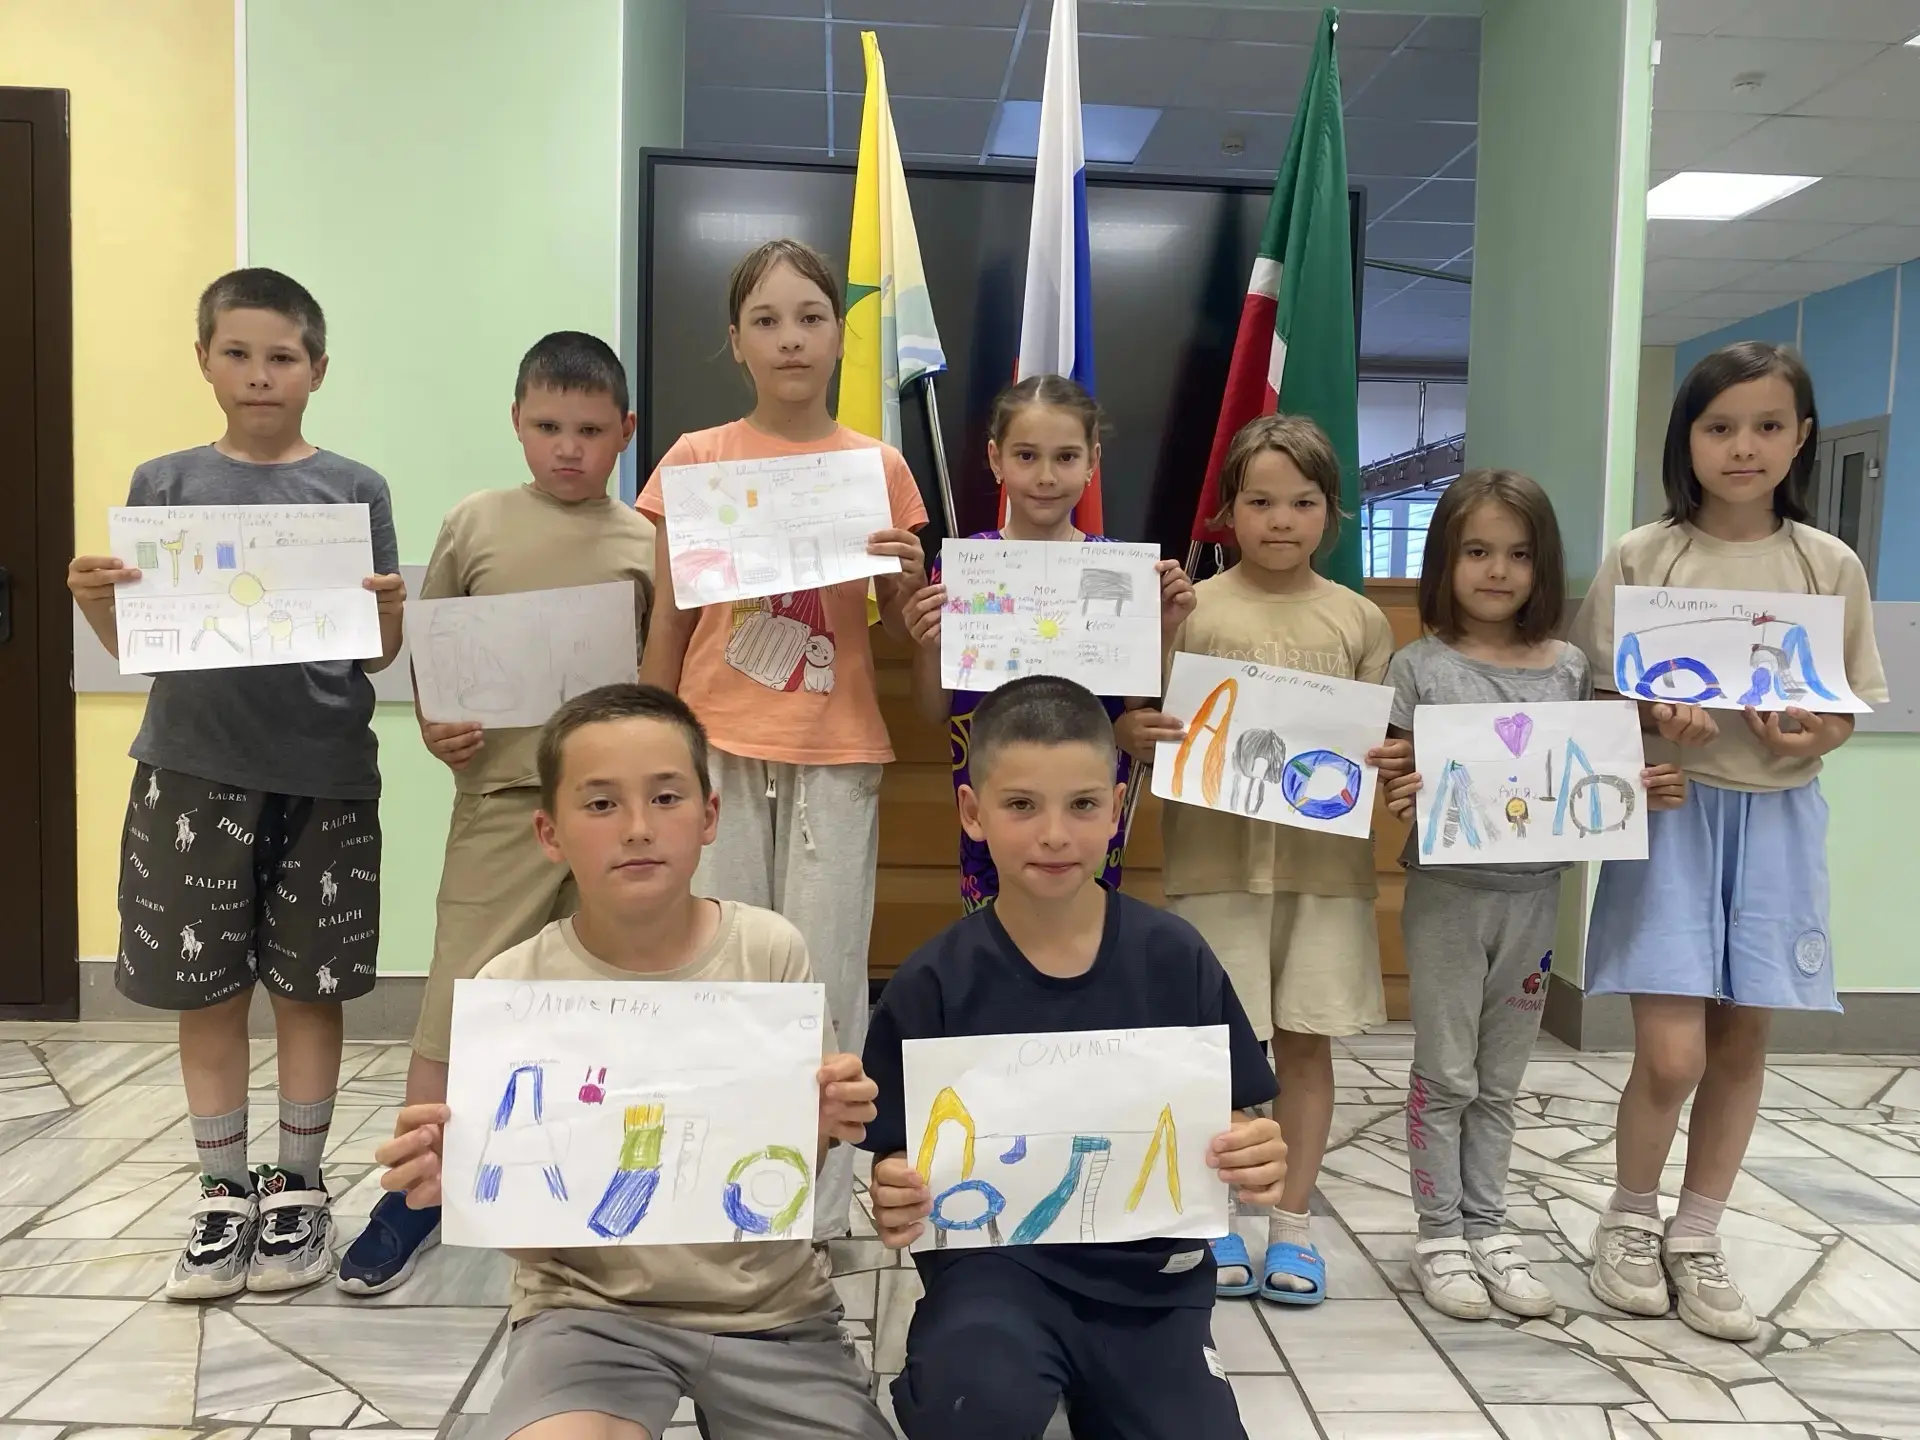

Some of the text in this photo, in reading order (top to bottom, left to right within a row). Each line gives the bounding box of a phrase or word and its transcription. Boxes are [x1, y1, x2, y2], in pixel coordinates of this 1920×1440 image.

[208, 791, 248, 802] LAUREN
[216, 816, 255, 846] POLO
[321, 812, 357, 832] RALPH
[129, 826, 150, 843] AUREN
[340, 834, 374, 848] LAUREN
[129, 851, 150, 879] POLO
[185, 875, 238, 890] RALPH
[350, 867, 377, 883] POLO
[135, 894, 165, 913] LAUREN
[318, 909, 363, 928] RALPH
[134, 924, 159, 950] POLO
[220, 930, 247, 942] POLO
[343, 930, 375, 945] LAUREN
[268, 939, 297, 958] LAUREN
[176, 967, 226, 983] RALPH
[353, 963, 376, 975] POLO
[269, 966, 294, 992] POLO
[204, 982, 241, 1001] LAUREN
[1408, 1073, 1437, 1199] AMONG US
